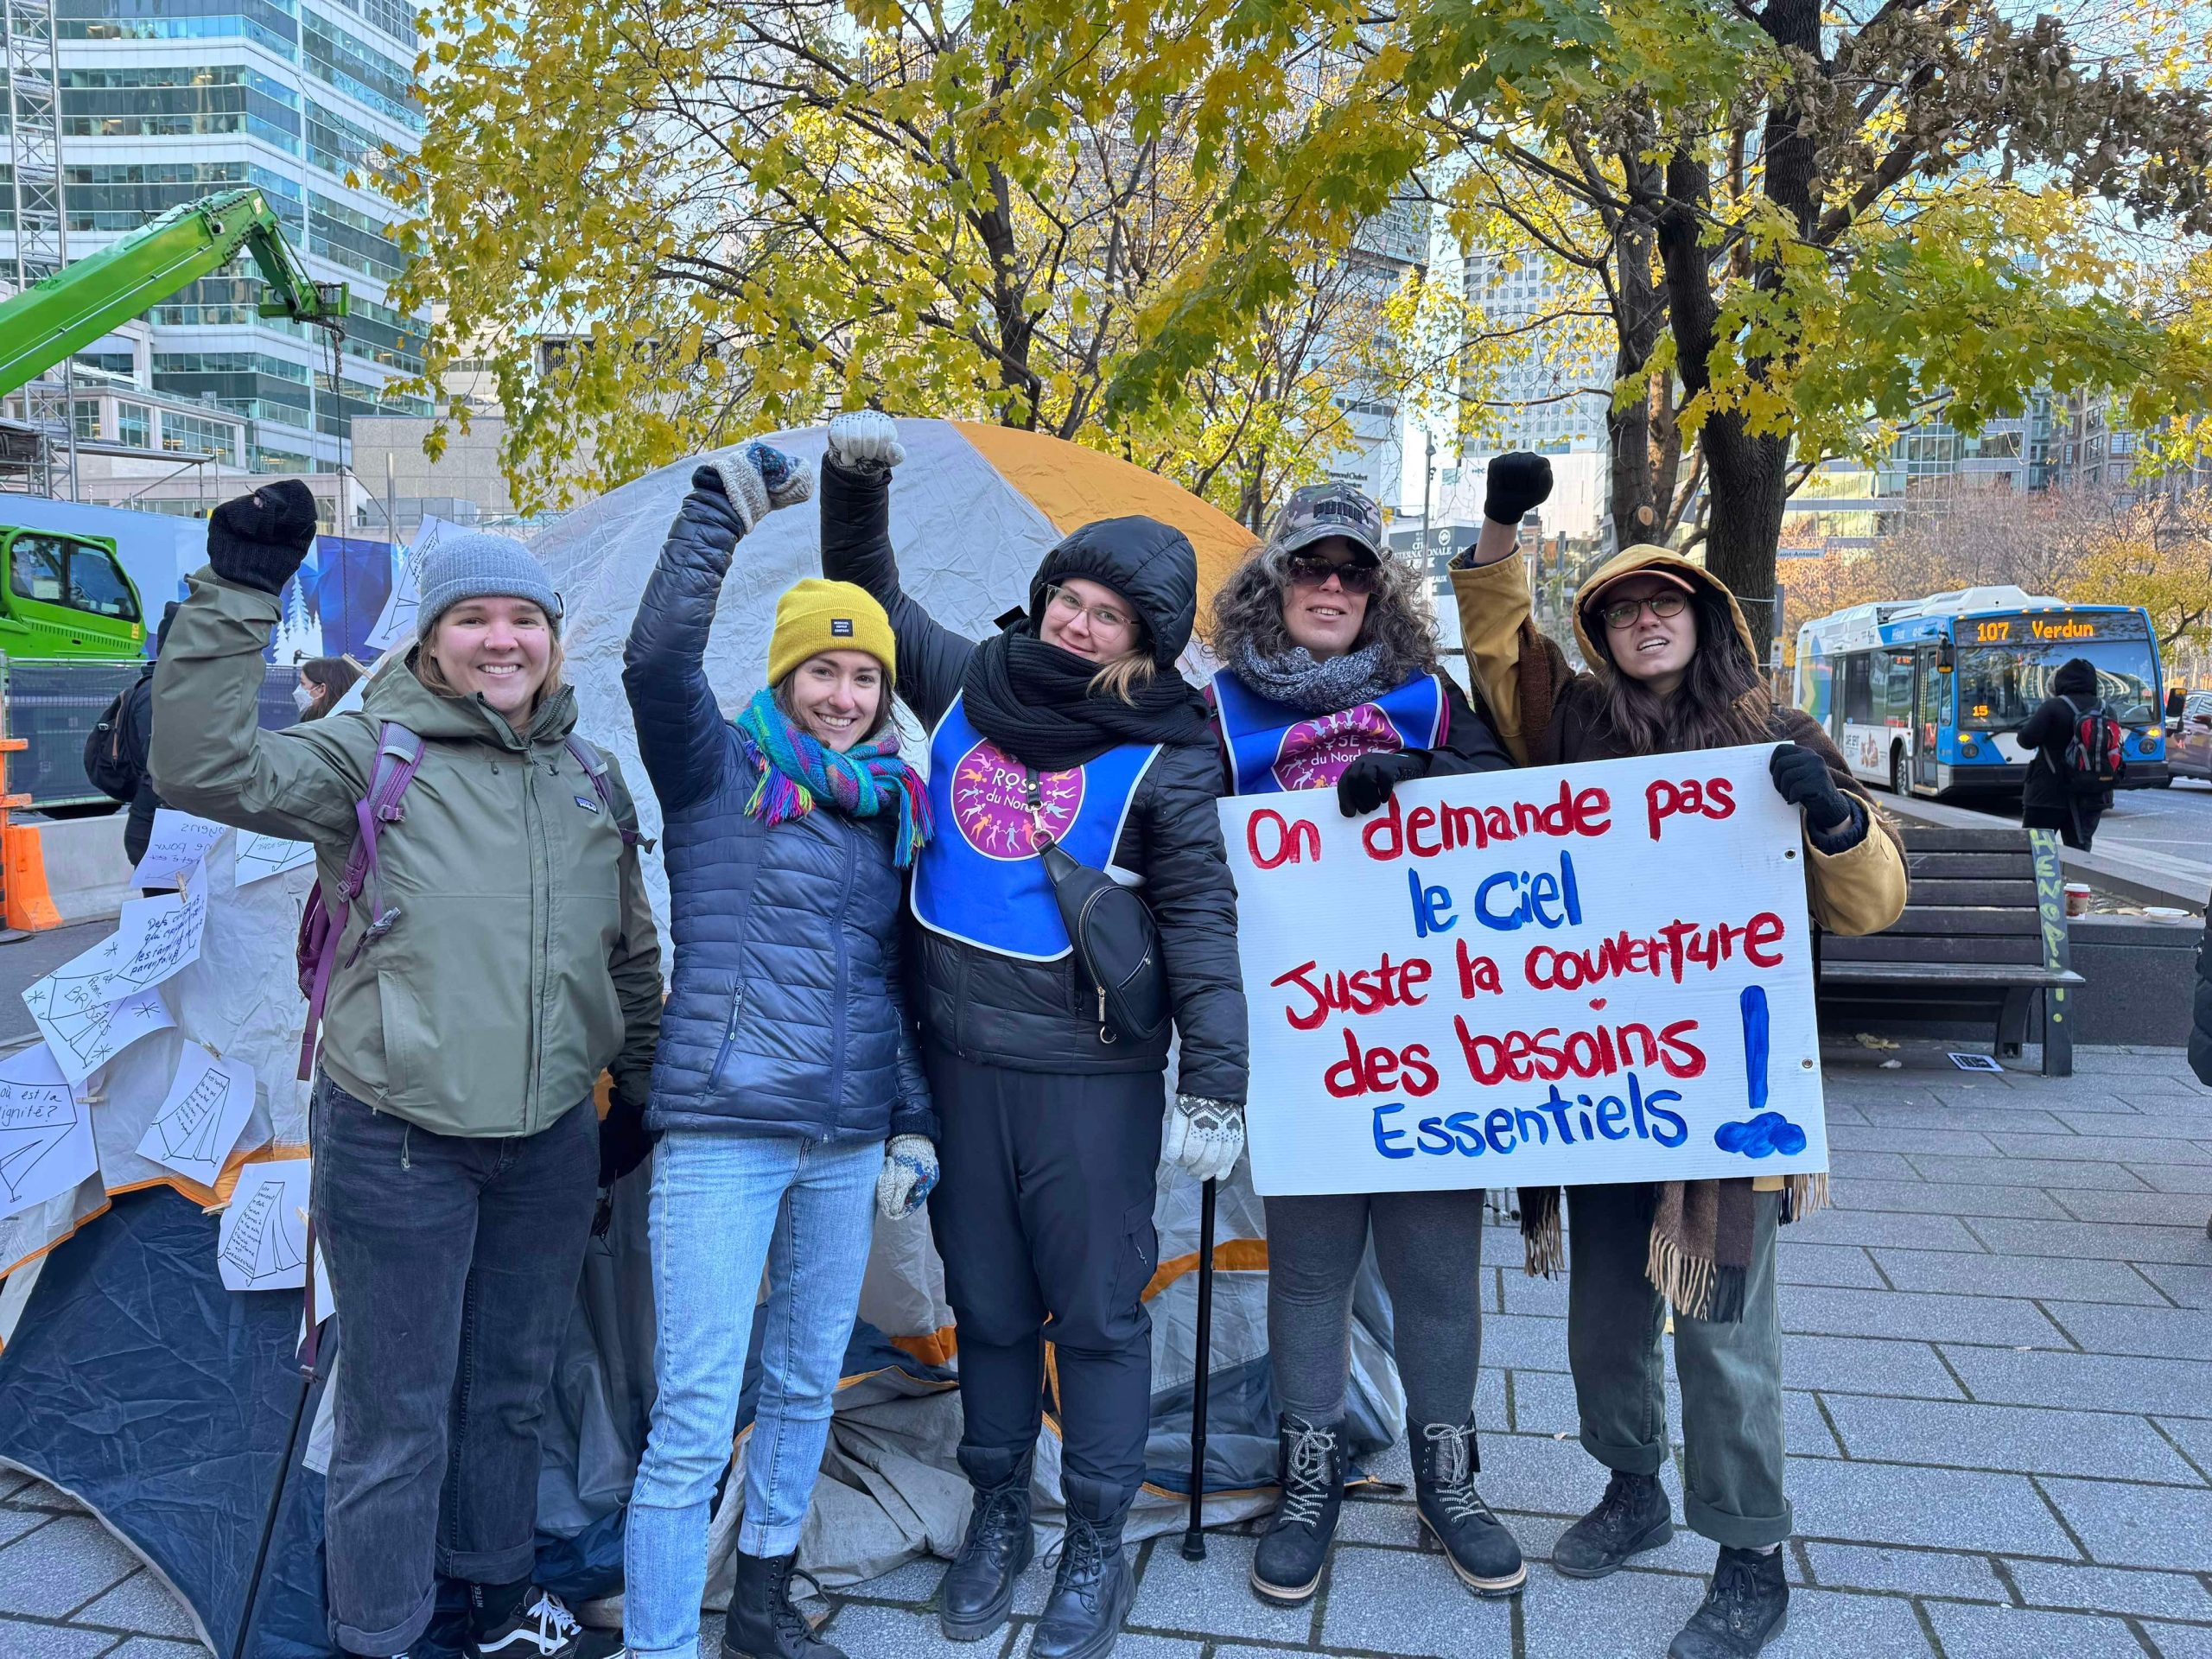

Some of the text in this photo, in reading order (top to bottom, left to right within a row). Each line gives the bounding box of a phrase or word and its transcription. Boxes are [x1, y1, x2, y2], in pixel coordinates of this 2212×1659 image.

[1313, 501, 1363, 524] PUMA
[1977, 619, 2094, 642] 107 Verdun
[1972, 704, 1989, 717] 15
[1311, 752, 1327, 766] du
[991, 767, 1044, 794] ROS
[986, 788, 1034, 814] du Nor
[1248, 778, 1737, 869] On demande pas
[1408, 849, 1583, 938] le Ciel
[1271, 912, 1785, 1031] Juste la couverture
[1325, 1002, 1707, 1098] des besoins
[21, 1089, 40, 1100] est
[43, 1090, 63, 1103] la
[0, 1104, 59, 1128] ignité?
[1372, 1071, 1689, 1160] Essentiels
